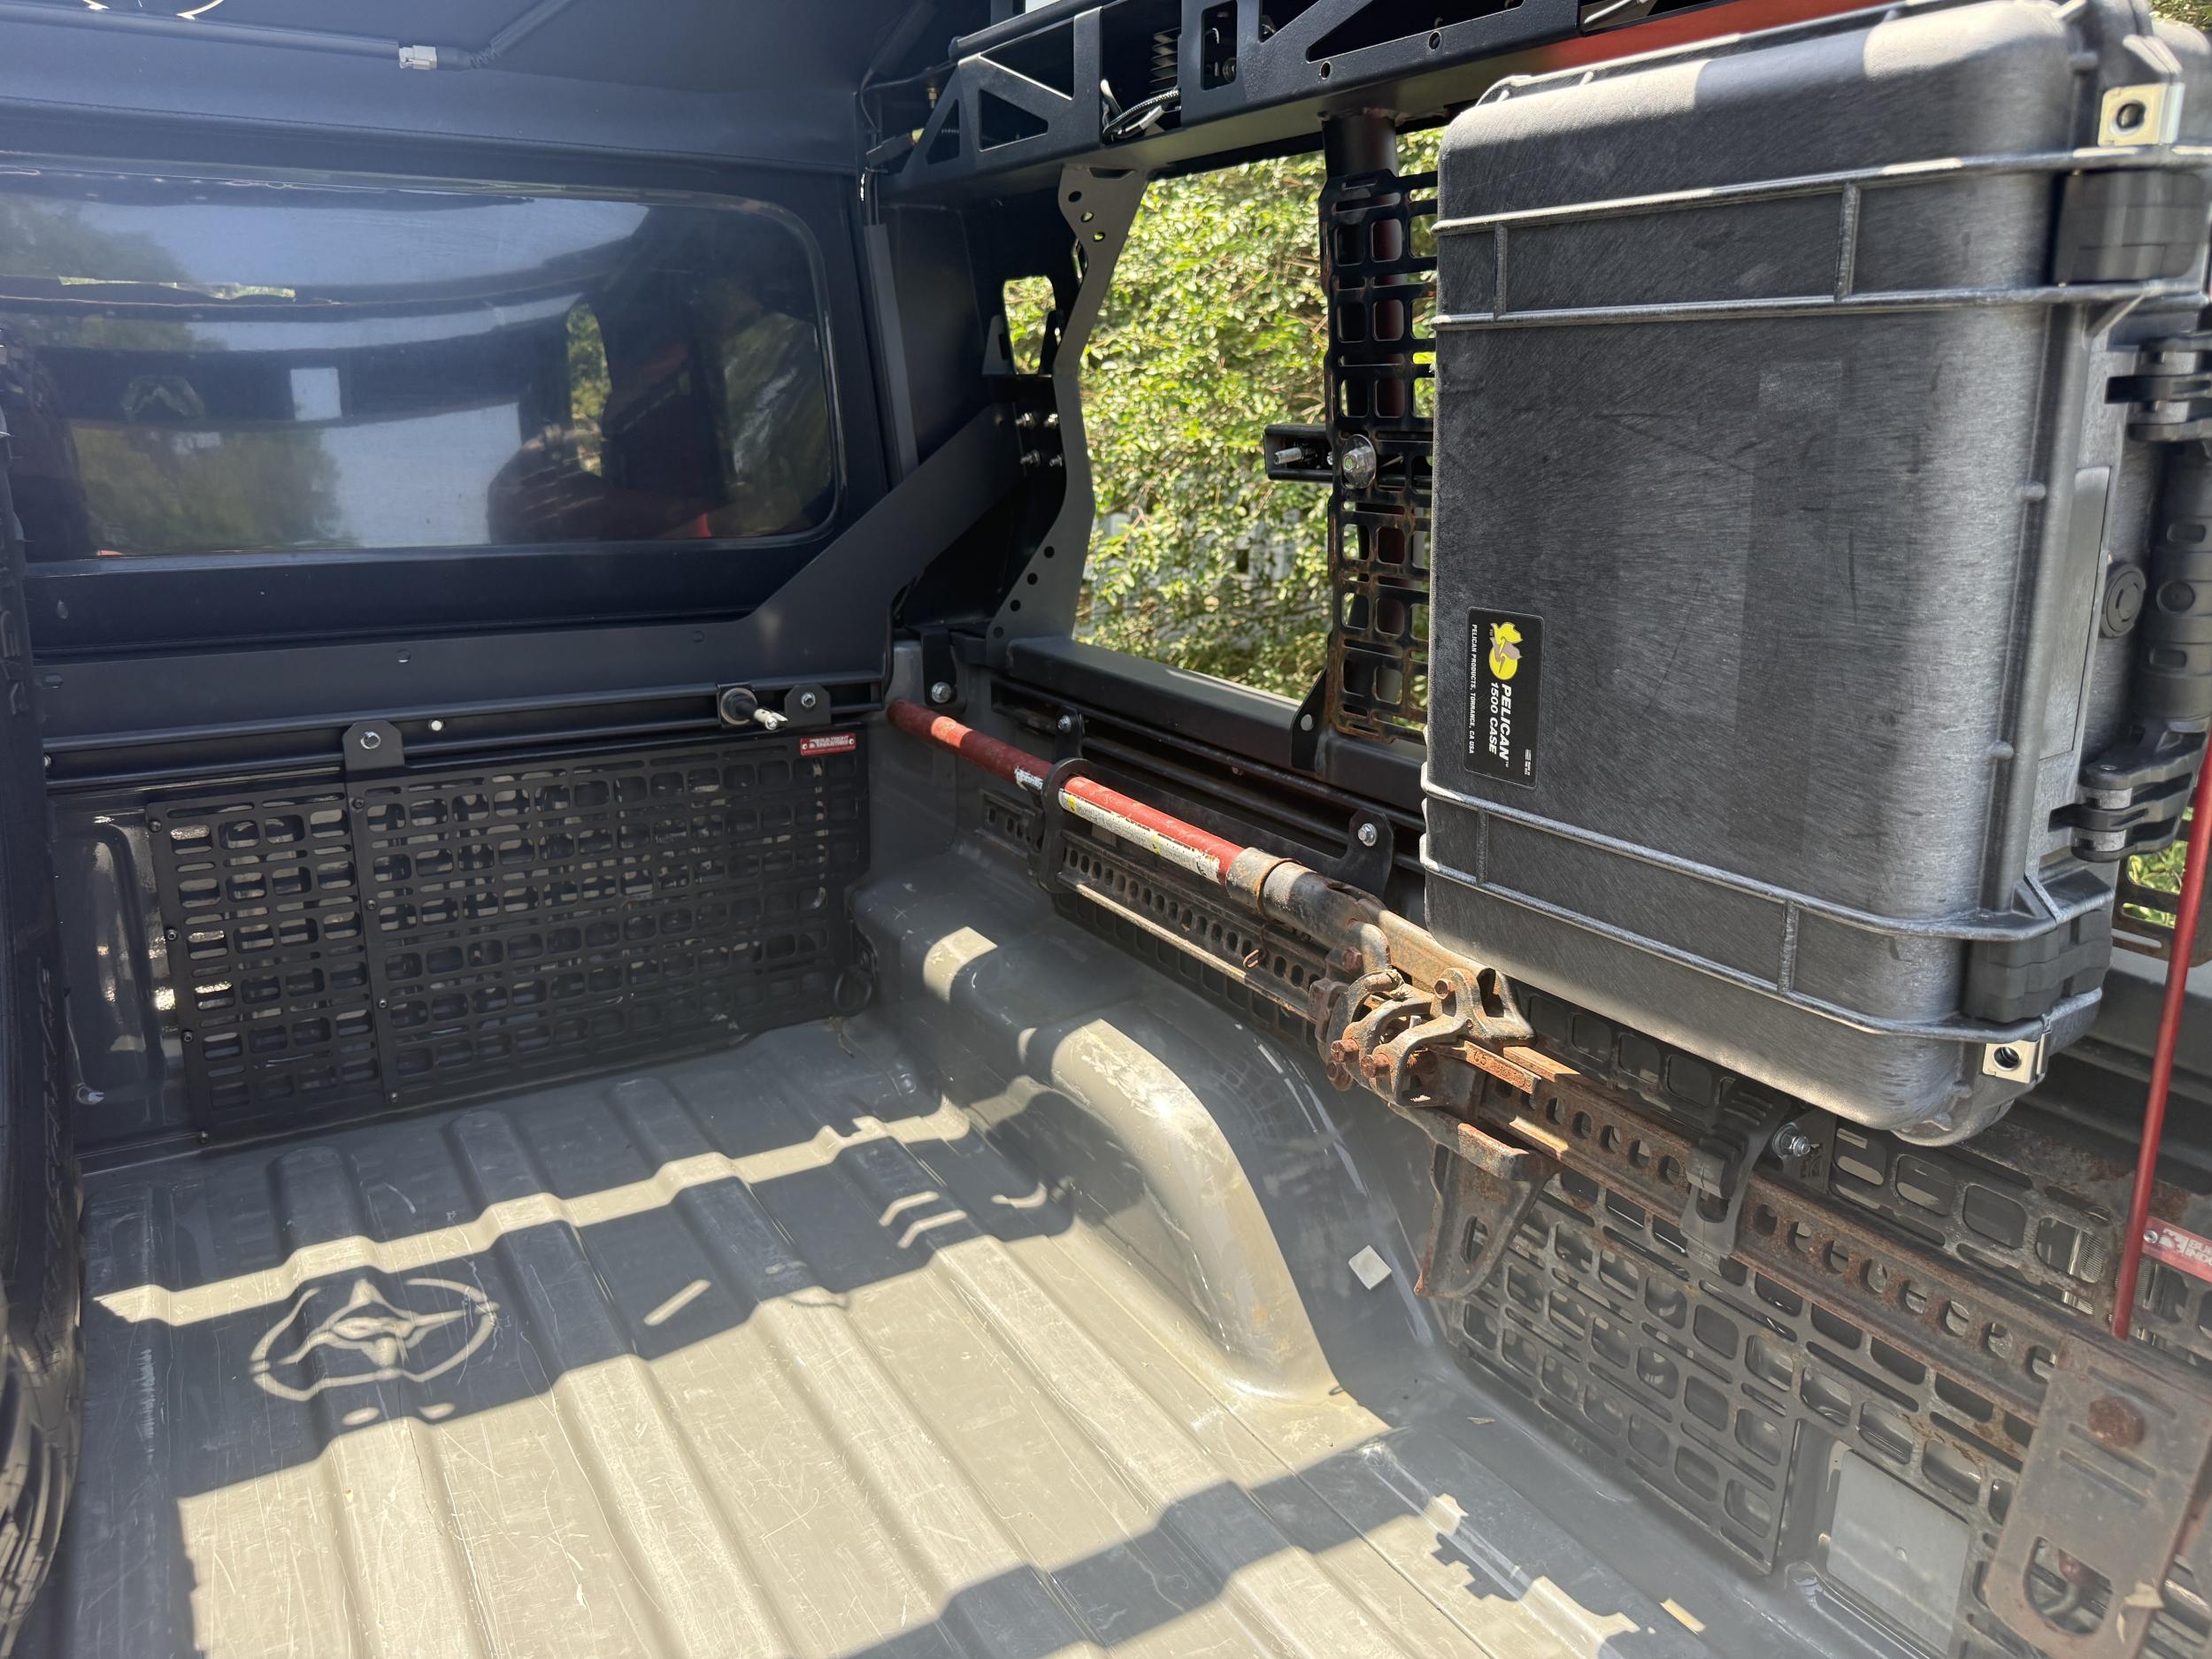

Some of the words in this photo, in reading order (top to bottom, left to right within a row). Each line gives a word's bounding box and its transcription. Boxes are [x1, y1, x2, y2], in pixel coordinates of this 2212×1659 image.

[1490, 682, 1499, 714] 1500
[1469, 730, 1475, 740] CA
[1488, 717, 1498, 755] CASE
